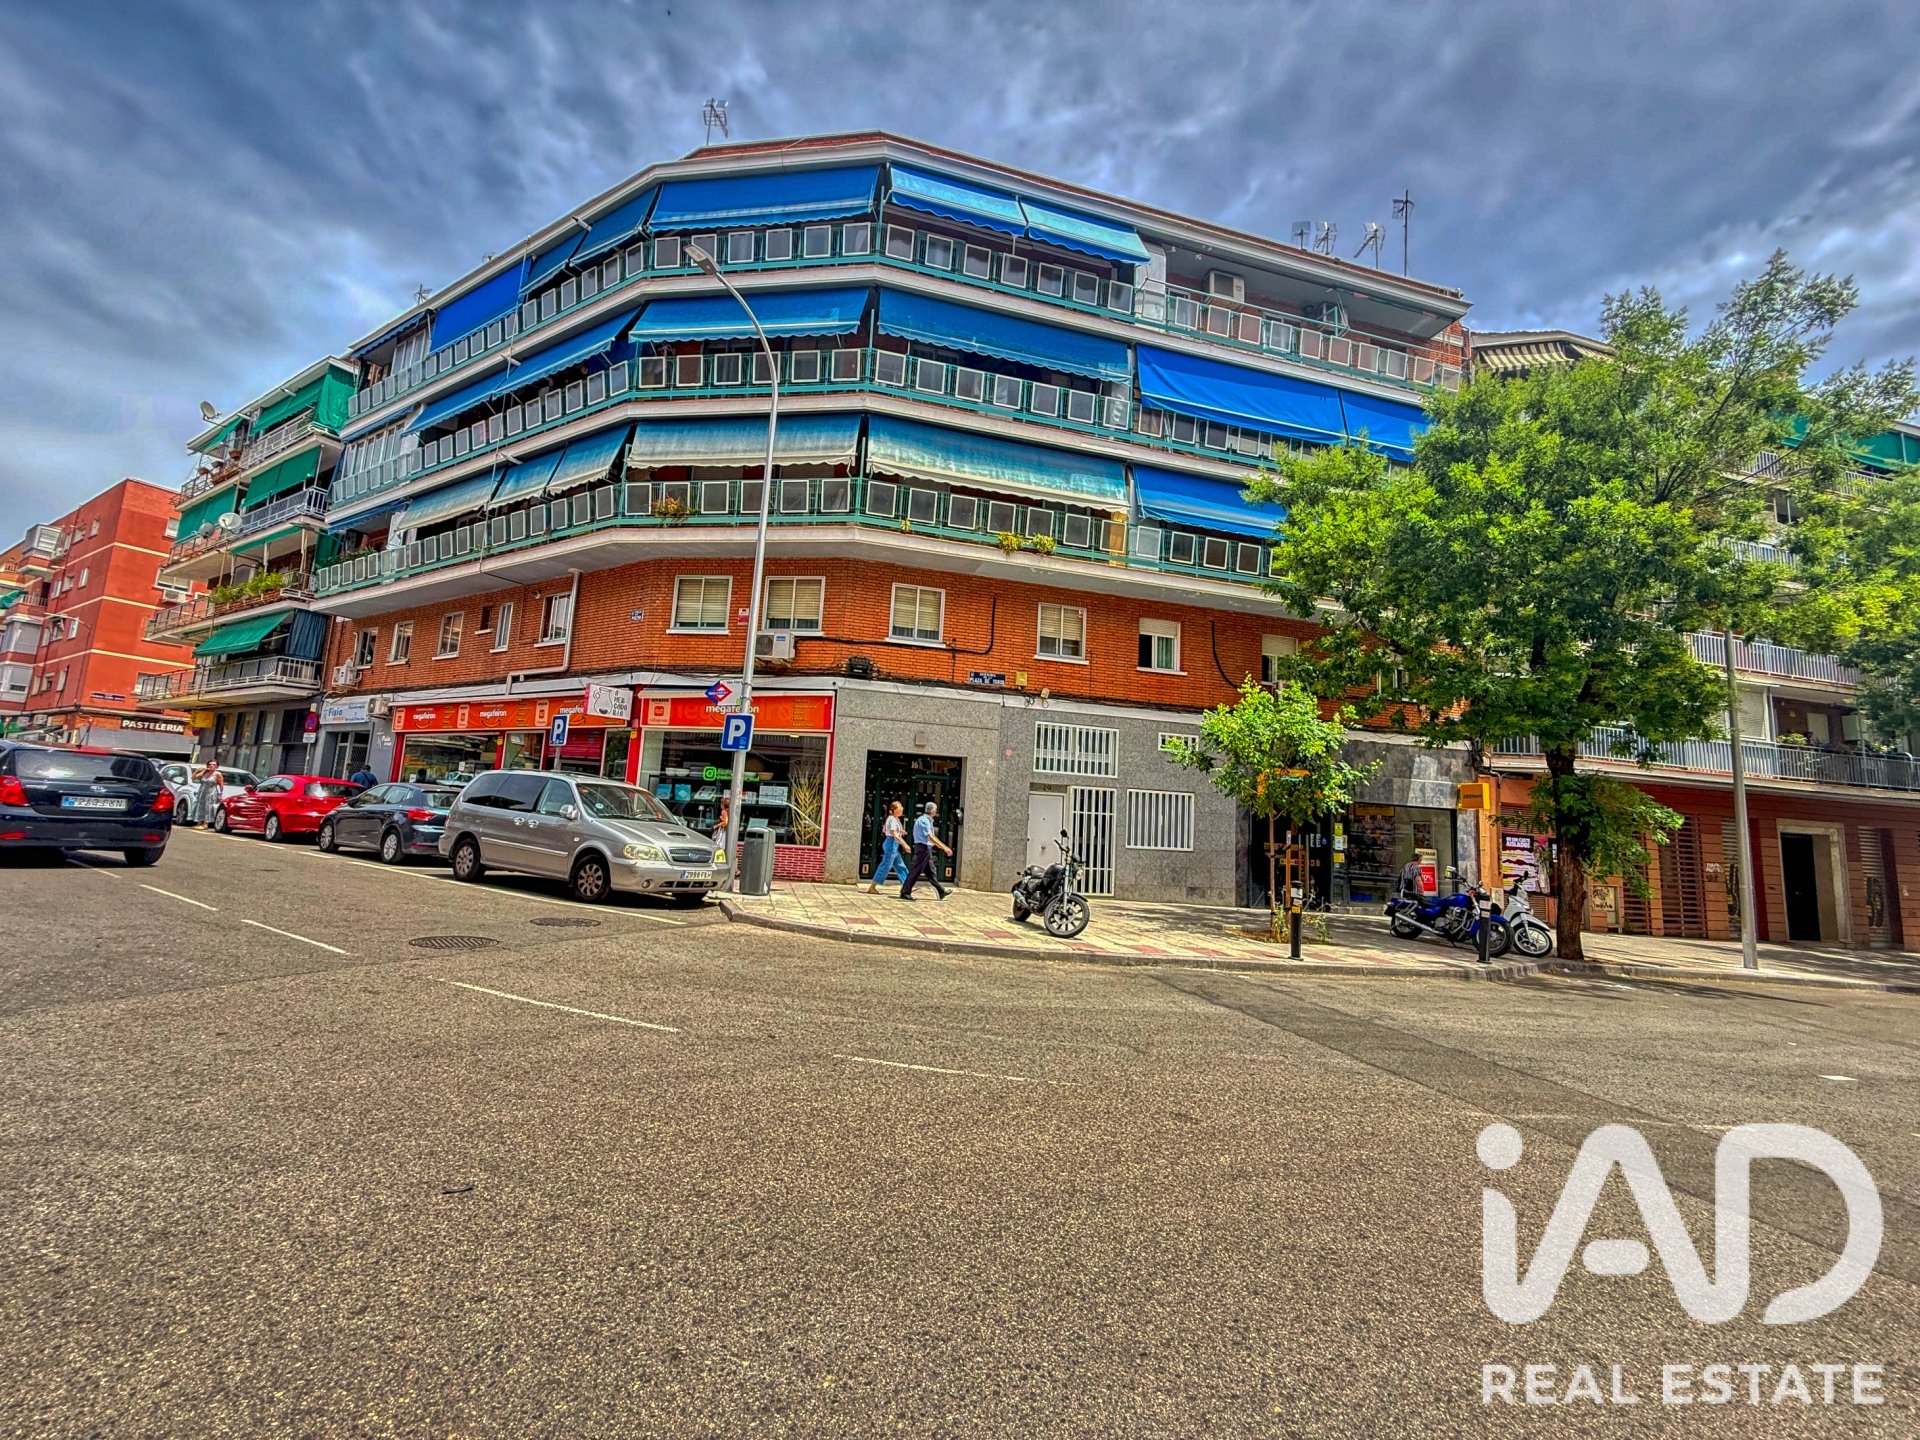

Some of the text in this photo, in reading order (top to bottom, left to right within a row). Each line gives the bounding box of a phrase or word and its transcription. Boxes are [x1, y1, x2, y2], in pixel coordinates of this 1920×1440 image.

[328, 707, 343, 717] Fisio
[480, 710, 507, 719] megafeiron
[560, 705, 585, 714] megafei
[705, 704, 759, 715] megafeon
[122, 720, 184, 732] PASTELERIA
[727, 718, 746, 746] P
